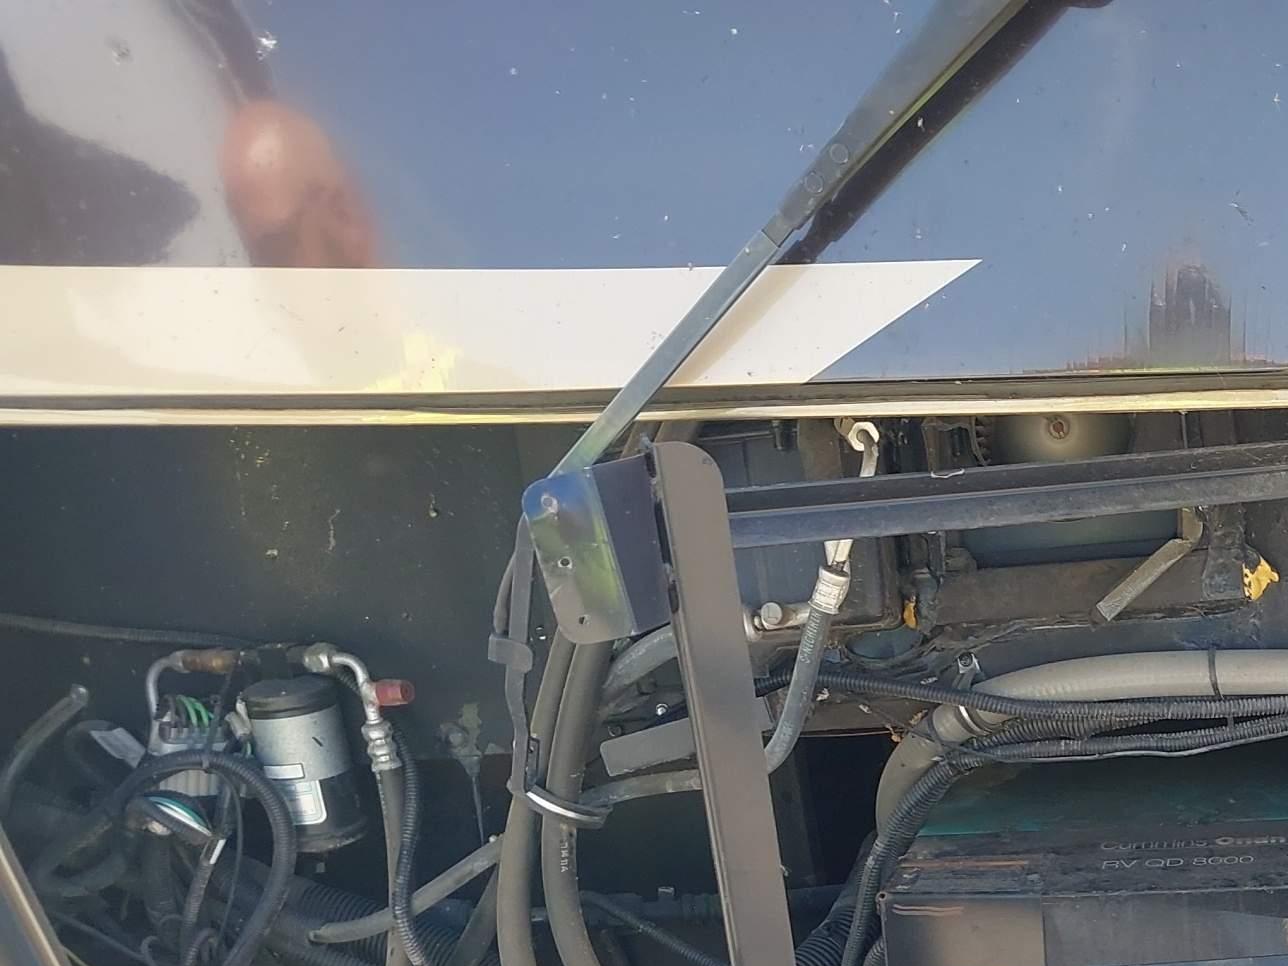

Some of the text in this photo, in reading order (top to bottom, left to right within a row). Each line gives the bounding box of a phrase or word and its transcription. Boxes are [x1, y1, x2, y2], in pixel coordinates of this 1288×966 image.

[1099, 836, 1287, 850] Cummins Onan
[1102, 855, 1255, 870] RV QD 8000
